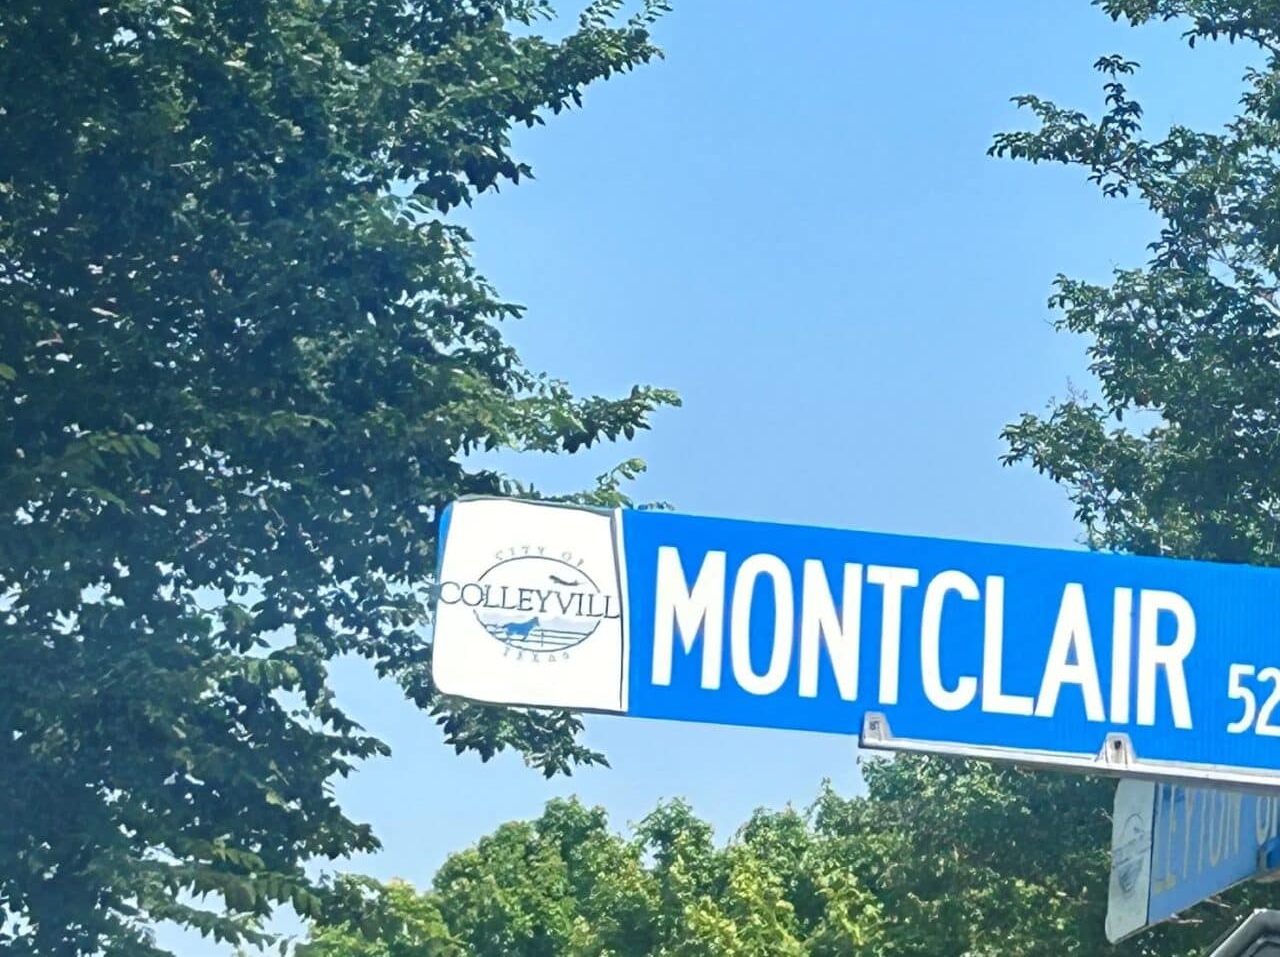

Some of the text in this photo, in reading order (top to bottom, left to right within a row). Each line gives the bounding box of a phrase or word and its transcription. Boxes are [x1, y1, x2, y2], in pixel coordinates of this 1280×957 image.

[495, 545, 585, 568] CITY OF
[650, 545, 1196, 730] MONTCLAIR
[503, 647, 570, 663] TEXAS
